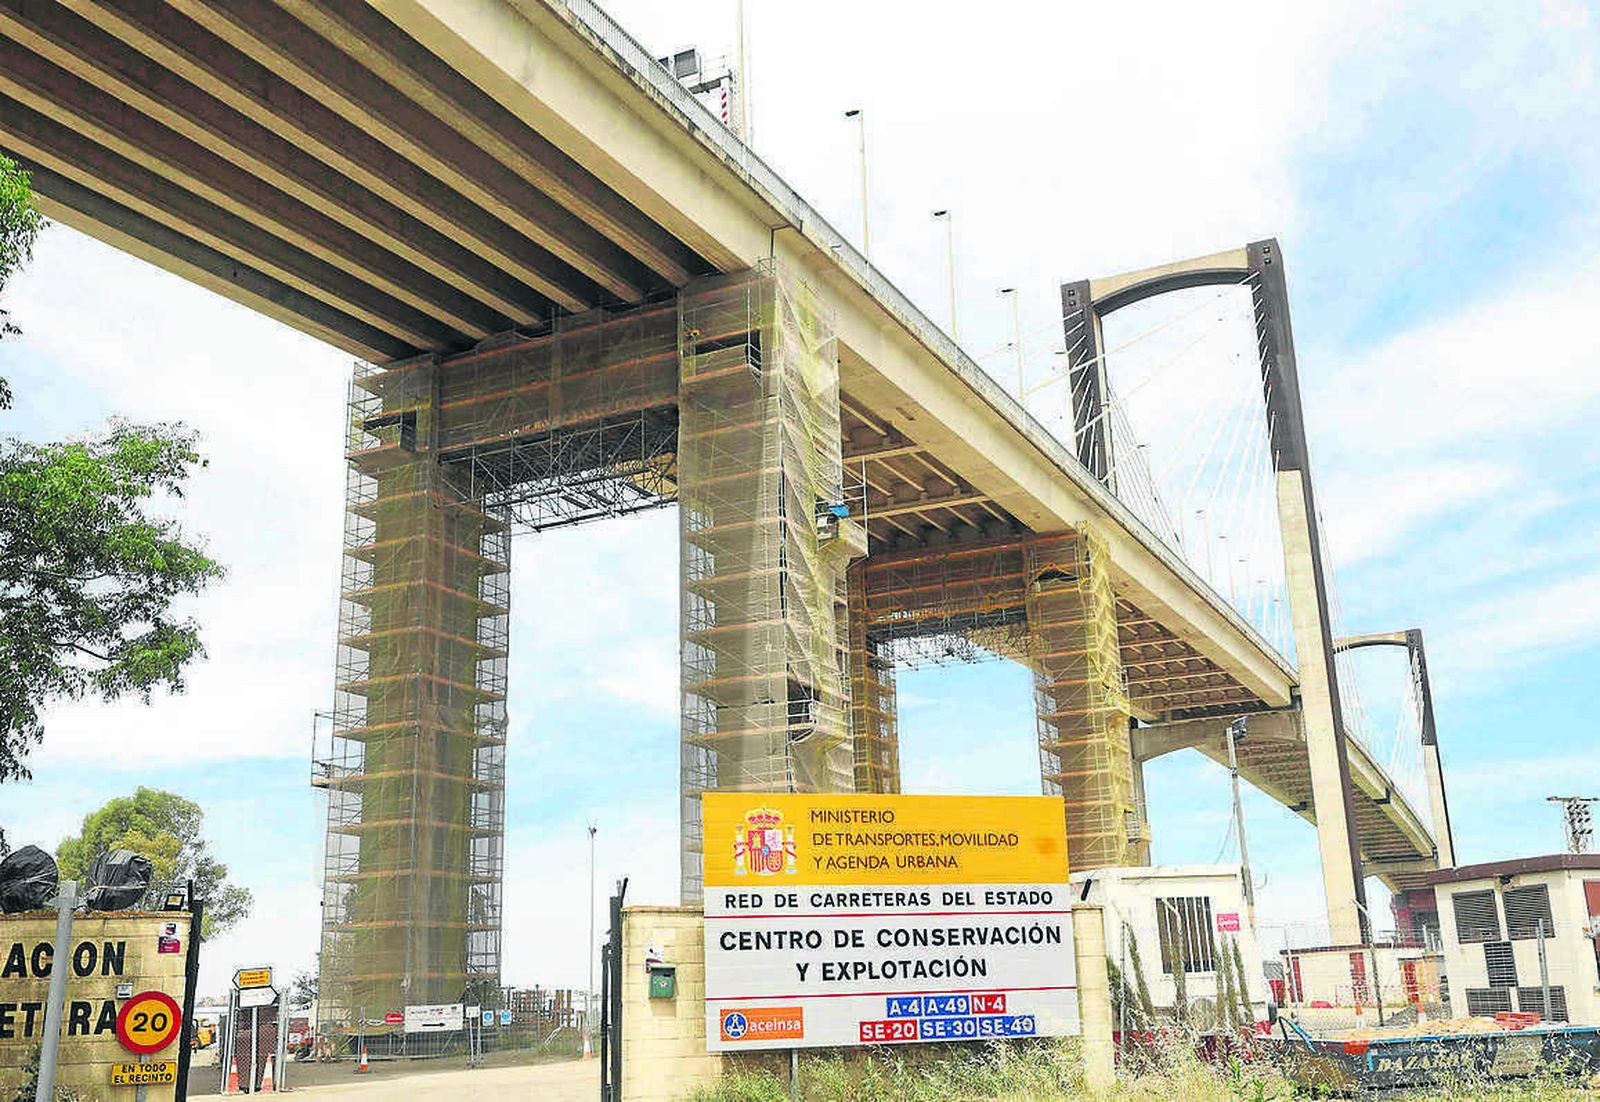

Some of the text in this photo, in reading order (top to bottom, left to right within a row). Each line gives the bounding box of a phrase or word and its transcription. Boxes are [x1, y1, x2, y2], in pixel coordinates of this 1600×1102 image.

[811, 810, 894, 823] MINISTERIO
[812, 833, 832, 846] DE
[940, 833, 1019, 846] MOVILIDAD
[813, 855, 958, 869] Y AGENDA URBANA
[725, 891, 1053, 908] RED DE CARRETERAS DEL ESTADO
[719, 922, 1062, 951] CENTRO DE CONSERVACIÓN
[2, 941, 126, 978] ACON
[796, 955, 987, 981] Y EXPLOTACIÓN
[889, 996, 1004, 1016] A-4 A-49 N-4
[0, 1001, 117, 1038] ETRA
[132, 1013, 168, 1032] 20
[862, 1017, 1034, 1039] SE-20 SE-30 SE-40
[121, 1063, 167, 1073] EN TODO
[114, 1073, 173, 1083] EL RECINTO
